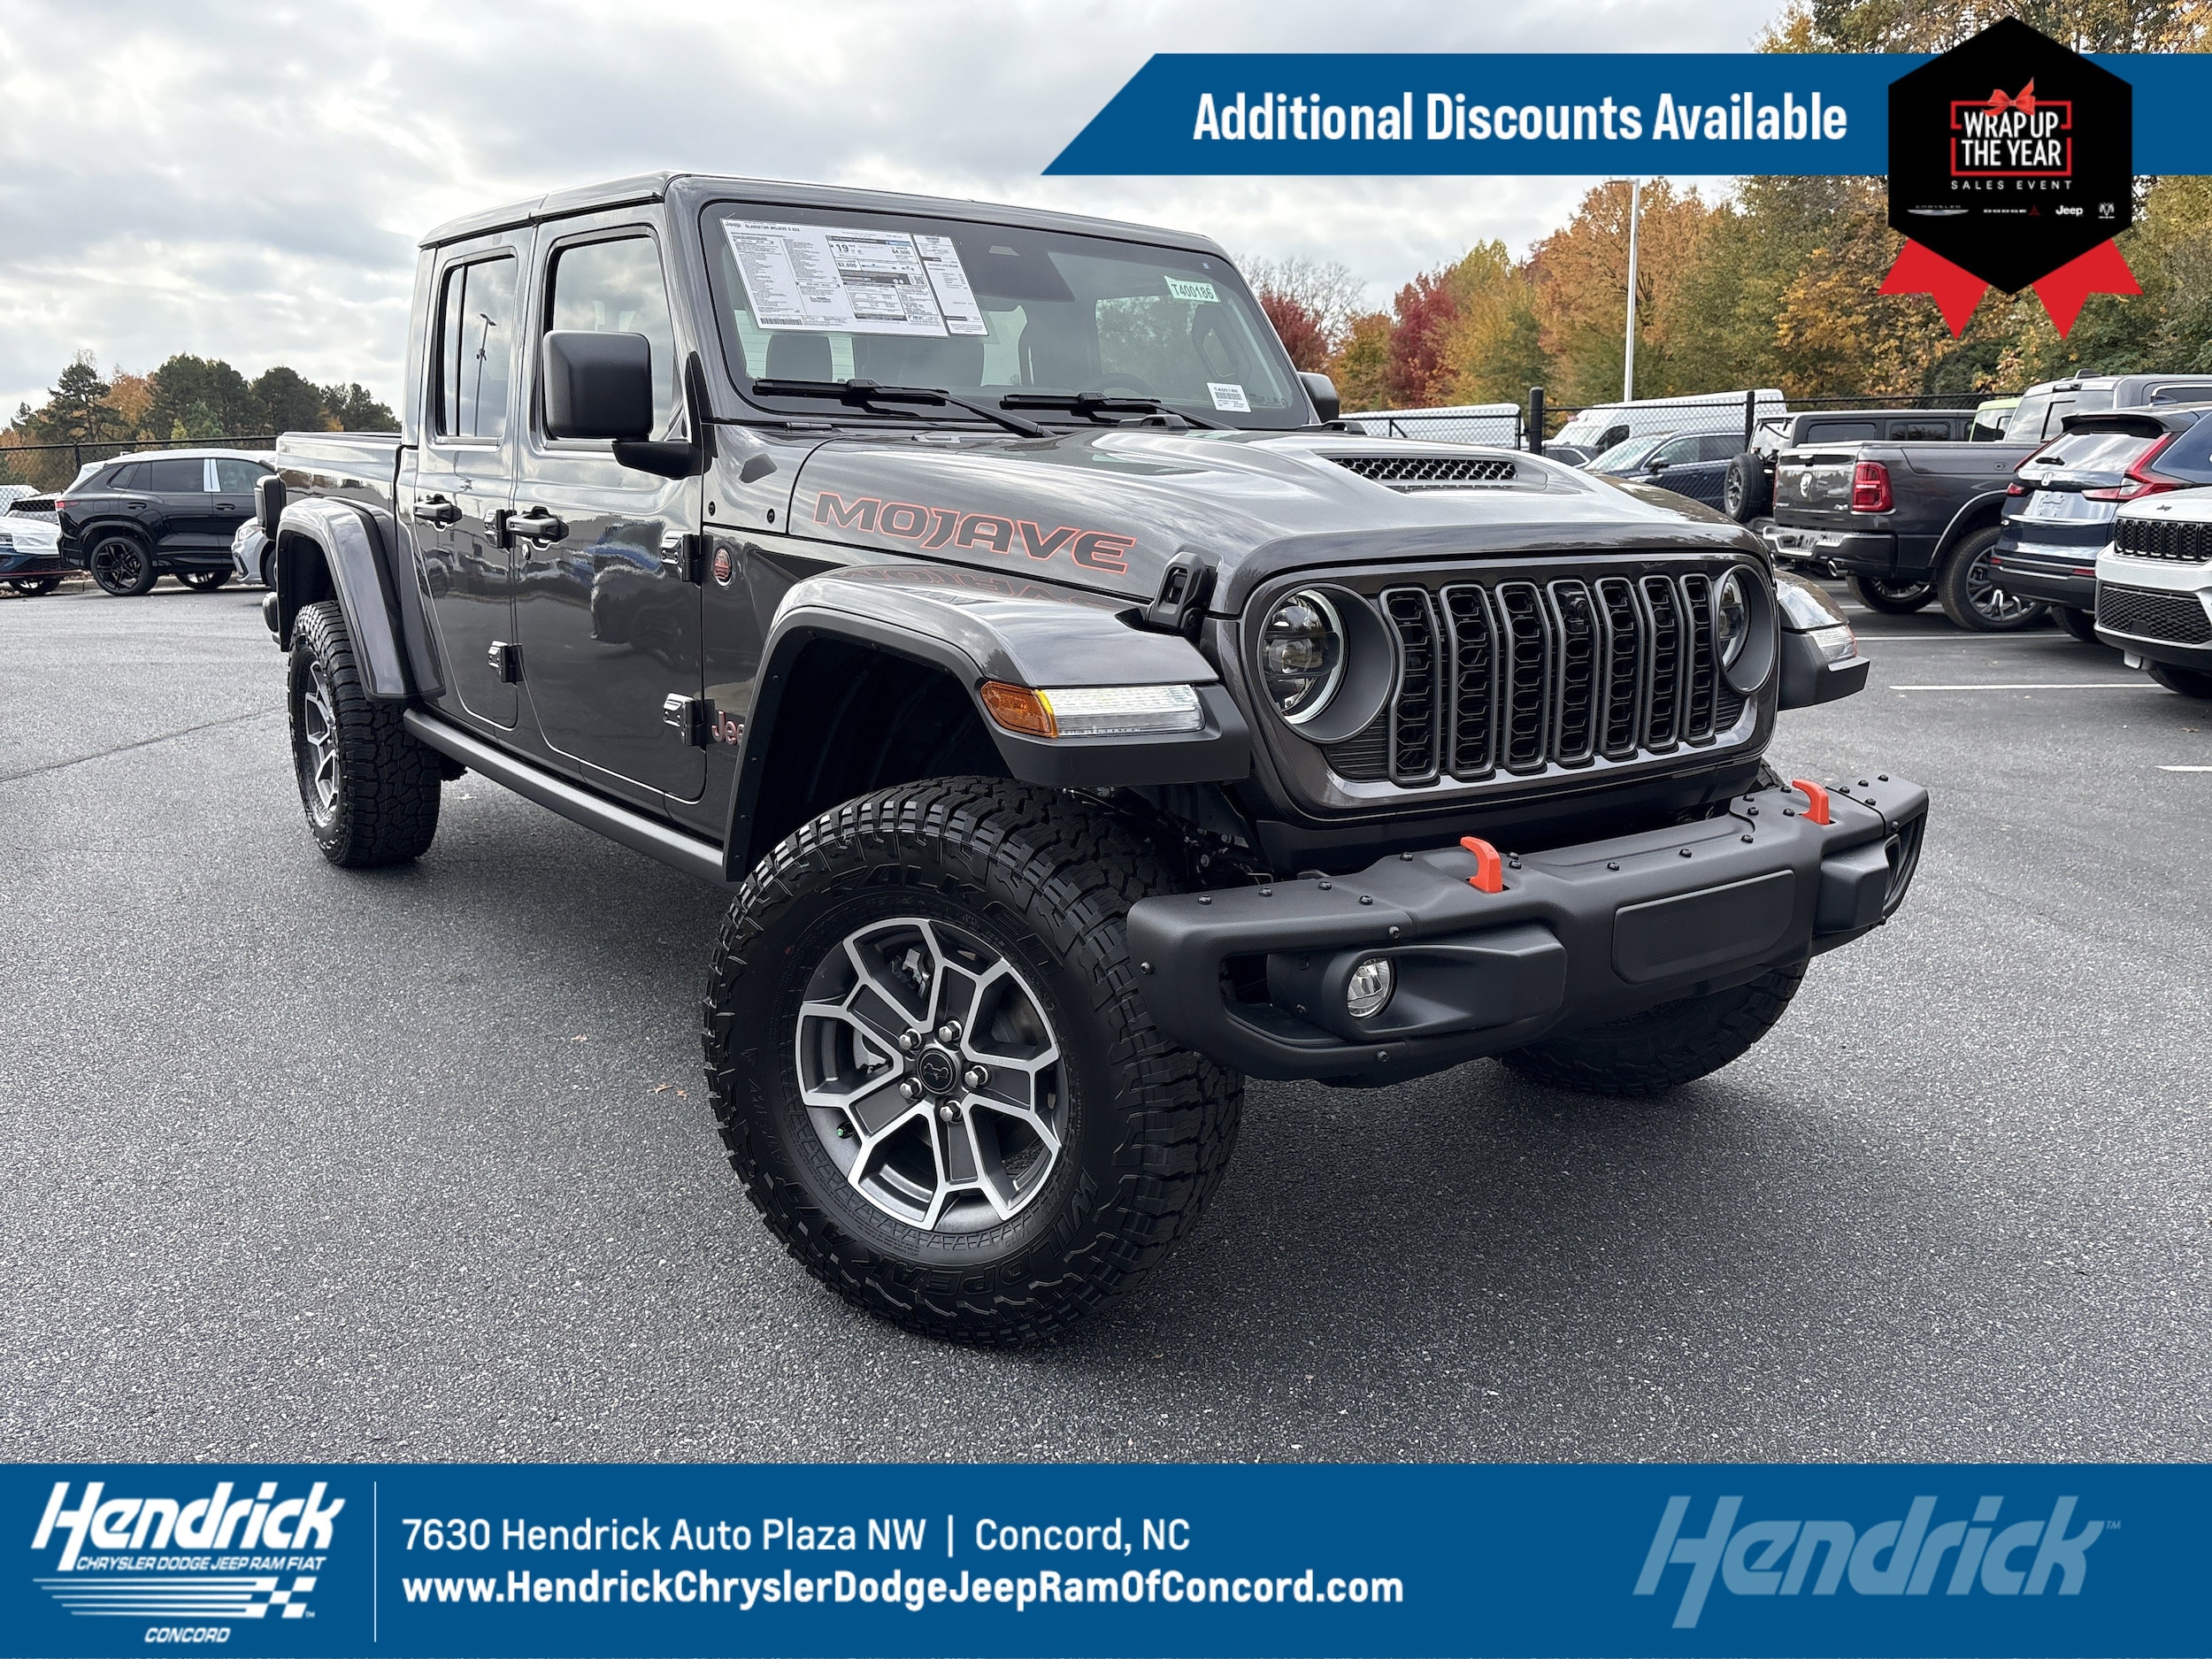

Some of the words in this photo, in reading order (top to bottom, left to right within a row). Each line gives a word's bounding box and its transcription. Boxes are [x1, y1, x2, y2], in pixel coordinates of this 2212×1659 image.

[836, 243, 849, 252] 19
[1171, 283, 1215, 300] T400186
[813, 491, 1137, 575] MOJAVE
[711, 710, 745, 745] Jee
